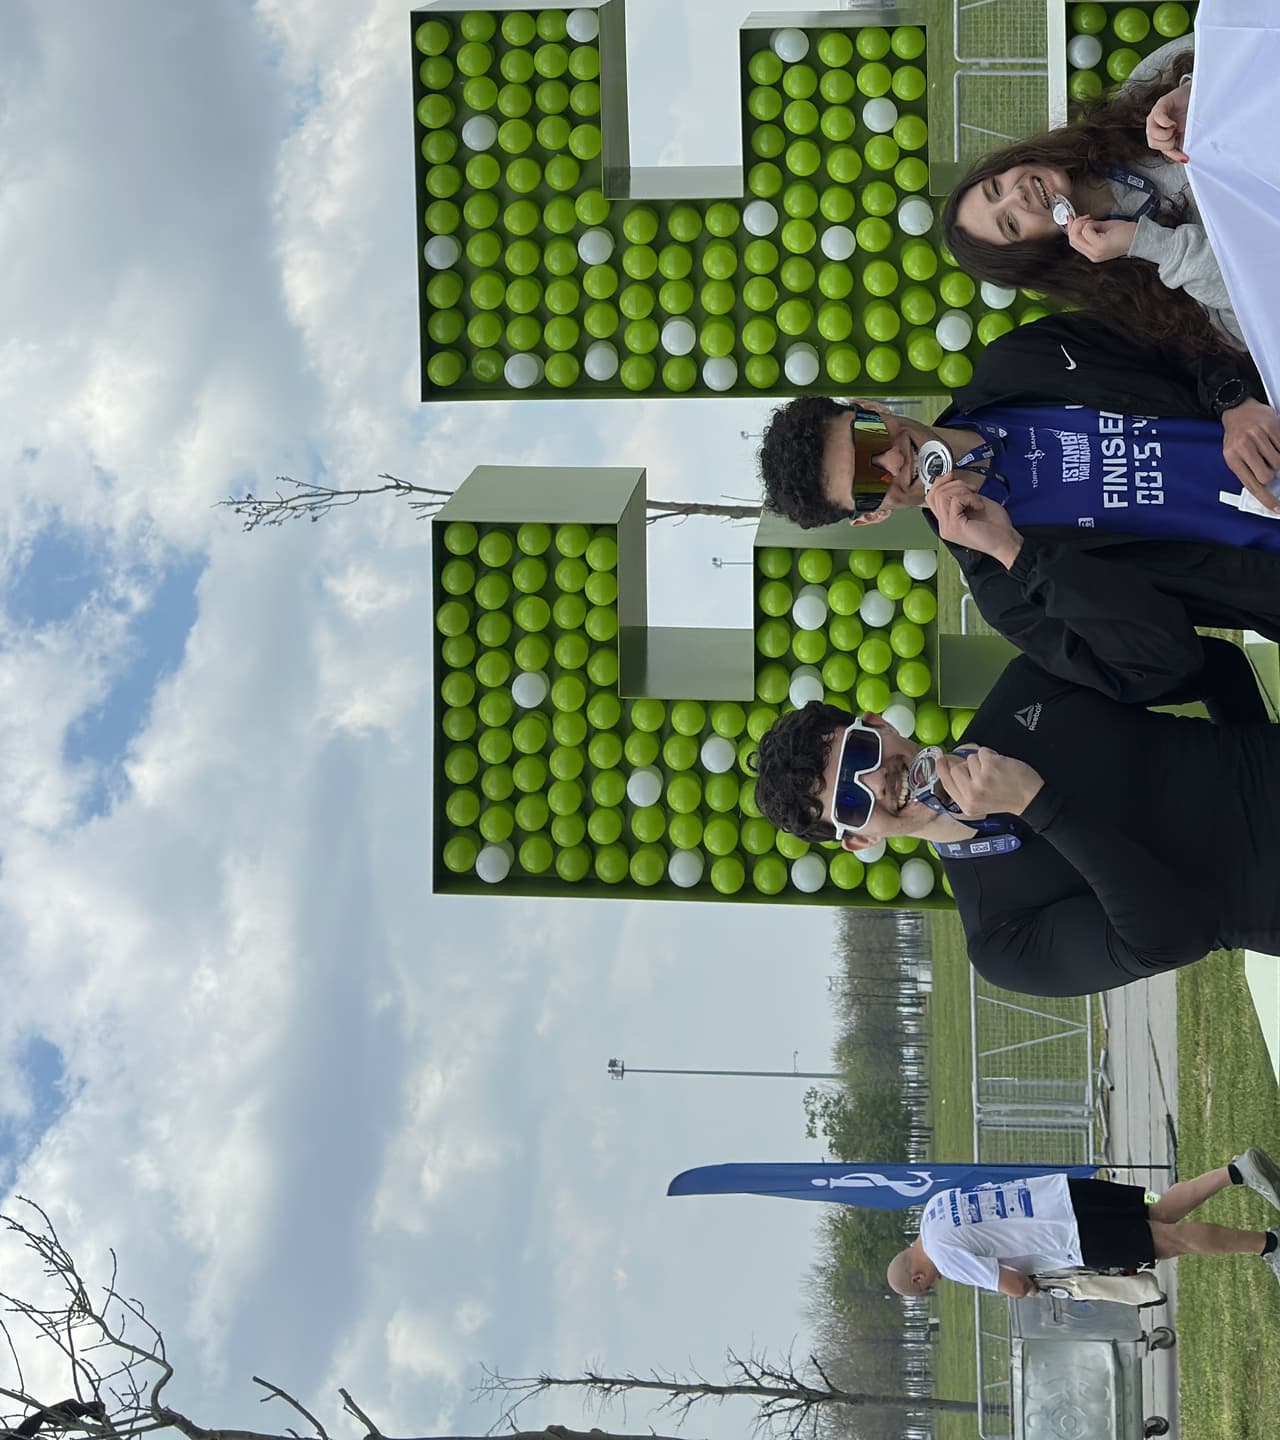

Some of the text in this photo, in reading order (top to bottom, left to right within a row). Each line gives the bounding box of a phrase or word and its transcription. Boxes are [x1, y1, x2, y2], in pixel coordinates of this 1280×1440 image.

[1078, 464, 1090, 481] YARI
[1099, 410, 1128, 508] FINISE
[1028, 702, 1042, 730] Reebok
